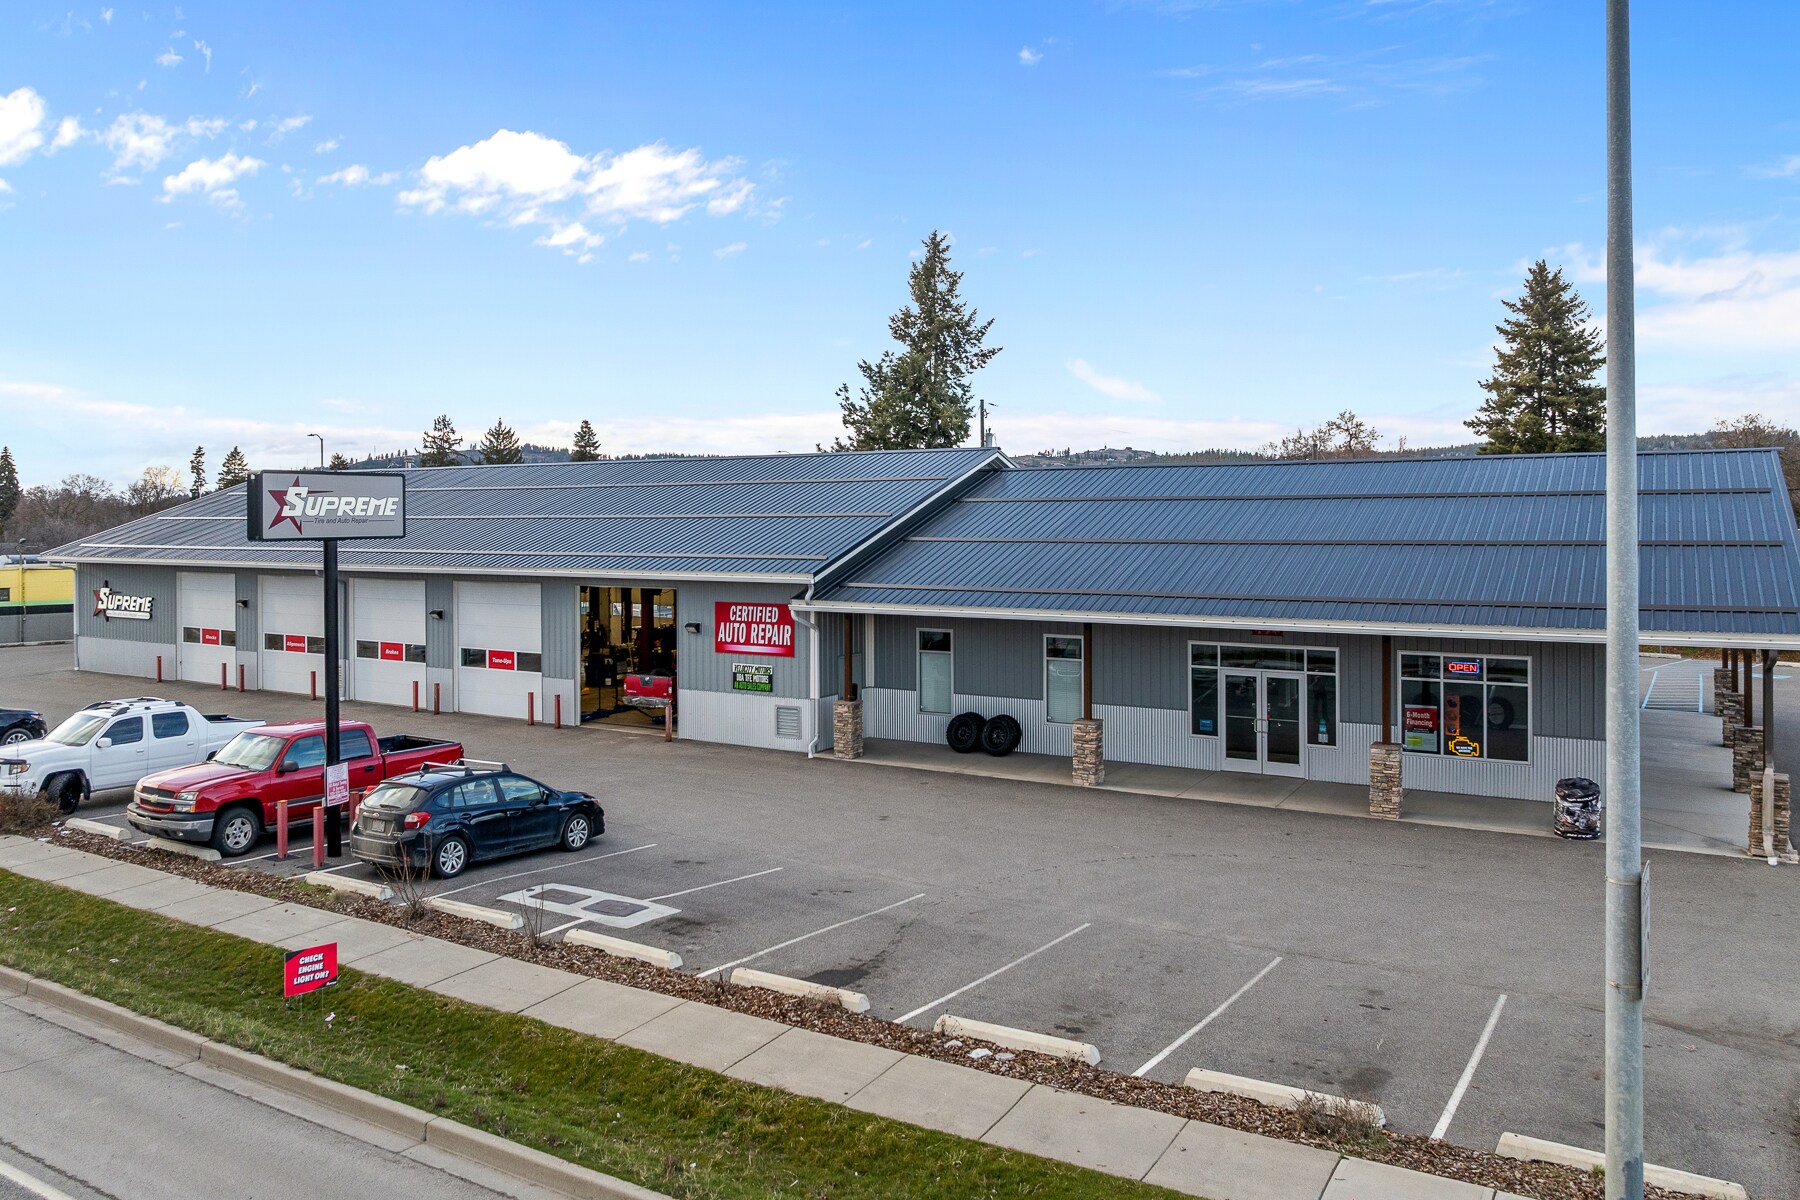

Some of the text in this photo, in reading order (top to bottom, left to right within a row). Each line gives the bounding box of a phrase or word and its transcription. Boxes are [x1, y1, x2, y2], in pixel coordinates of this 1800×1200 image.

[281, 486, 399, 517] SUPREME
[351, 517, 369, 525] Repair
[97, 587, 152, 612] SUPREME
[729, 605, 779, 622] CERTIFIED
[717, 622, 792, 646] AUTO REPAIR
[385, 648, 399, 656] Brakes
[1448, 663, 1477, 672] OPEN
[1406, 711, 1431, 719] 6-Month
[1406, 718, 1433, 728] Financing
[299, 953, 324, 964] CHECK
[298, 962, 324, 974] ENGINE
[293, 970, 329, 985] LIGHT ON?
